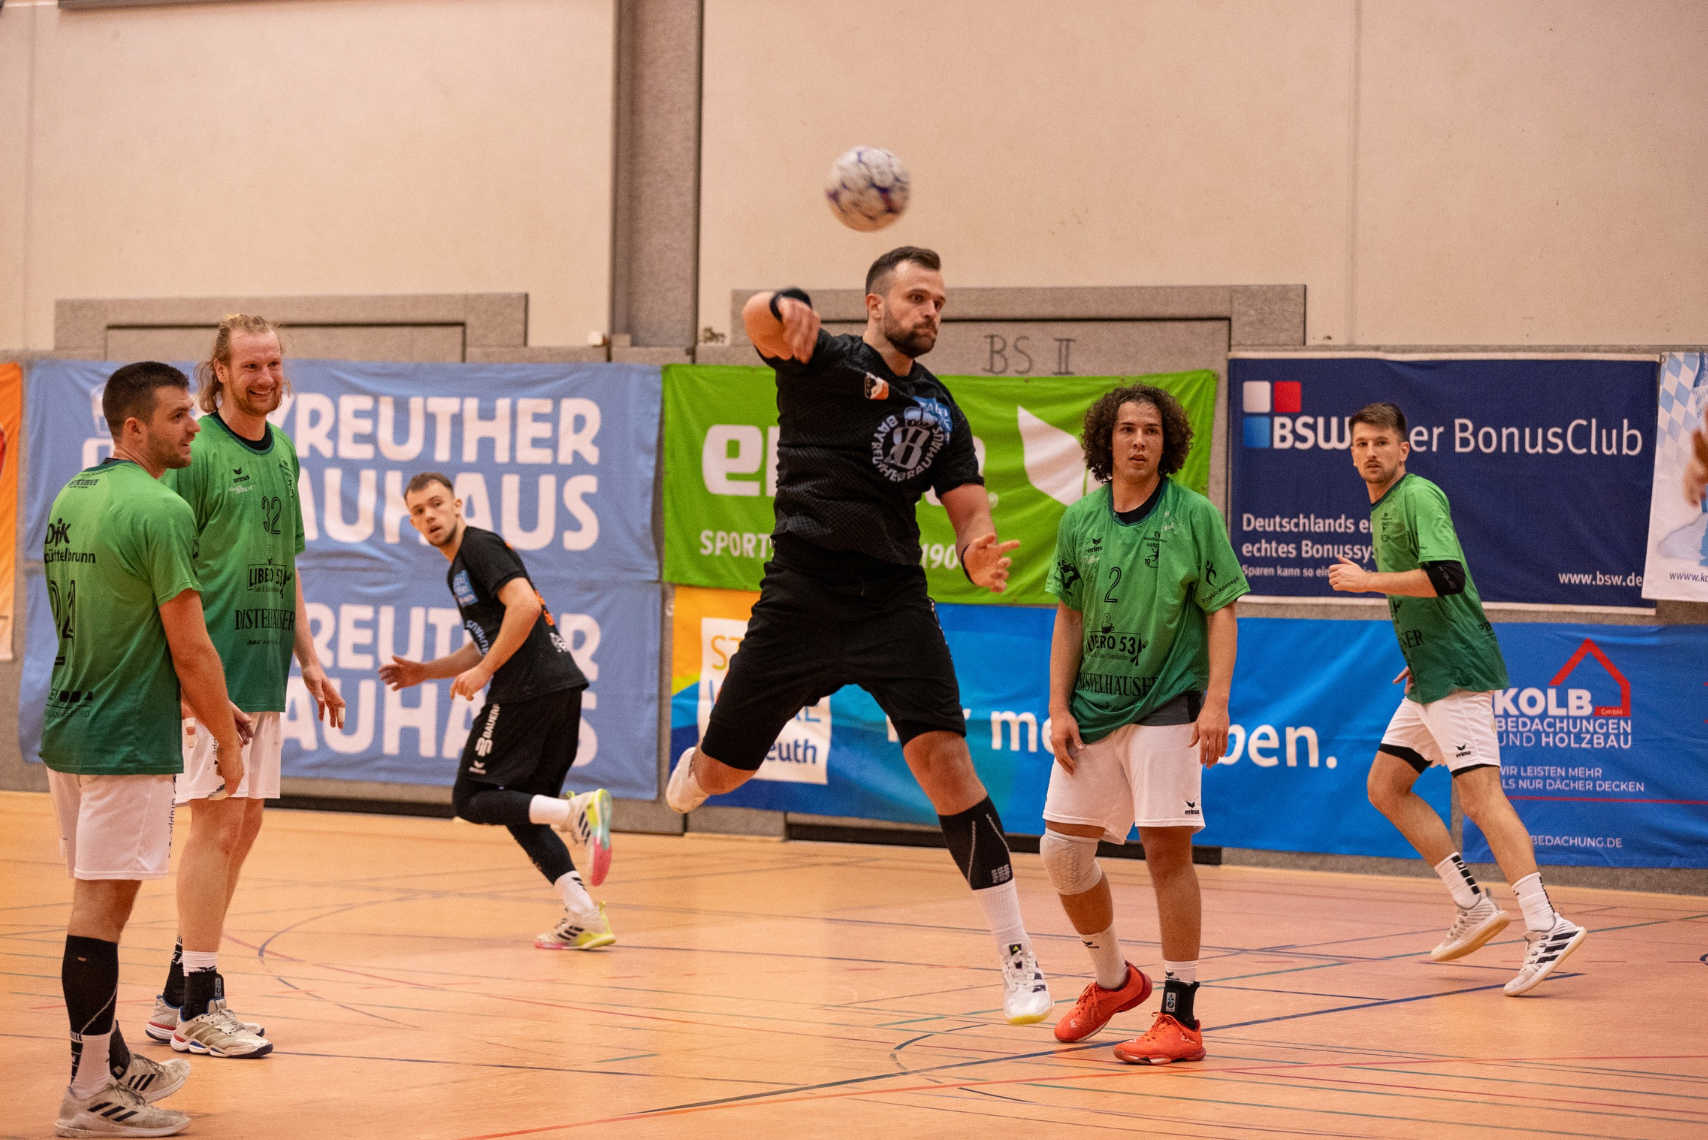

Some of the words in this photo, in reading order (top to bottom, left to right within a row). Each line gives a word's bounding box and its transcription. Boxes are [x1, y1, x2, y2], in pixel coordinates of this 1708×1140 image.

[982, 334, 1033, 375] BS
[1454, 417, 1643, 456] BonusClub
[262, 495, 282, 535] 32
[1242, 512, 1355, 533] Deutschlands
[700, 529, 775, 559] SPORT
[1241, 538, 1297, 558] echtes
[1277, 565, 1301, 577] kann
[1303, 568, 1314, 578] so
[1558, 571, 1642, 587] www.bsw.de
[1104, 566, 1122, 603] 2
[1118, 636, 1137, 655] 53
[1494, 687, 1593, 716] KOLB
[1496, 717, 1632, 734] BEDACHUNGEN
[1541, 733, 1632, 749] HOLZBAU
[1520, 766, 1565, 778] LEISTEN
[1568, 767, 1602, 779] MEHR
[1518, 778, 1543, 790] NUR
[1546, 777, 1593, 791] DÄCHER
[1595, 781, 1644, 792] DECKEN
